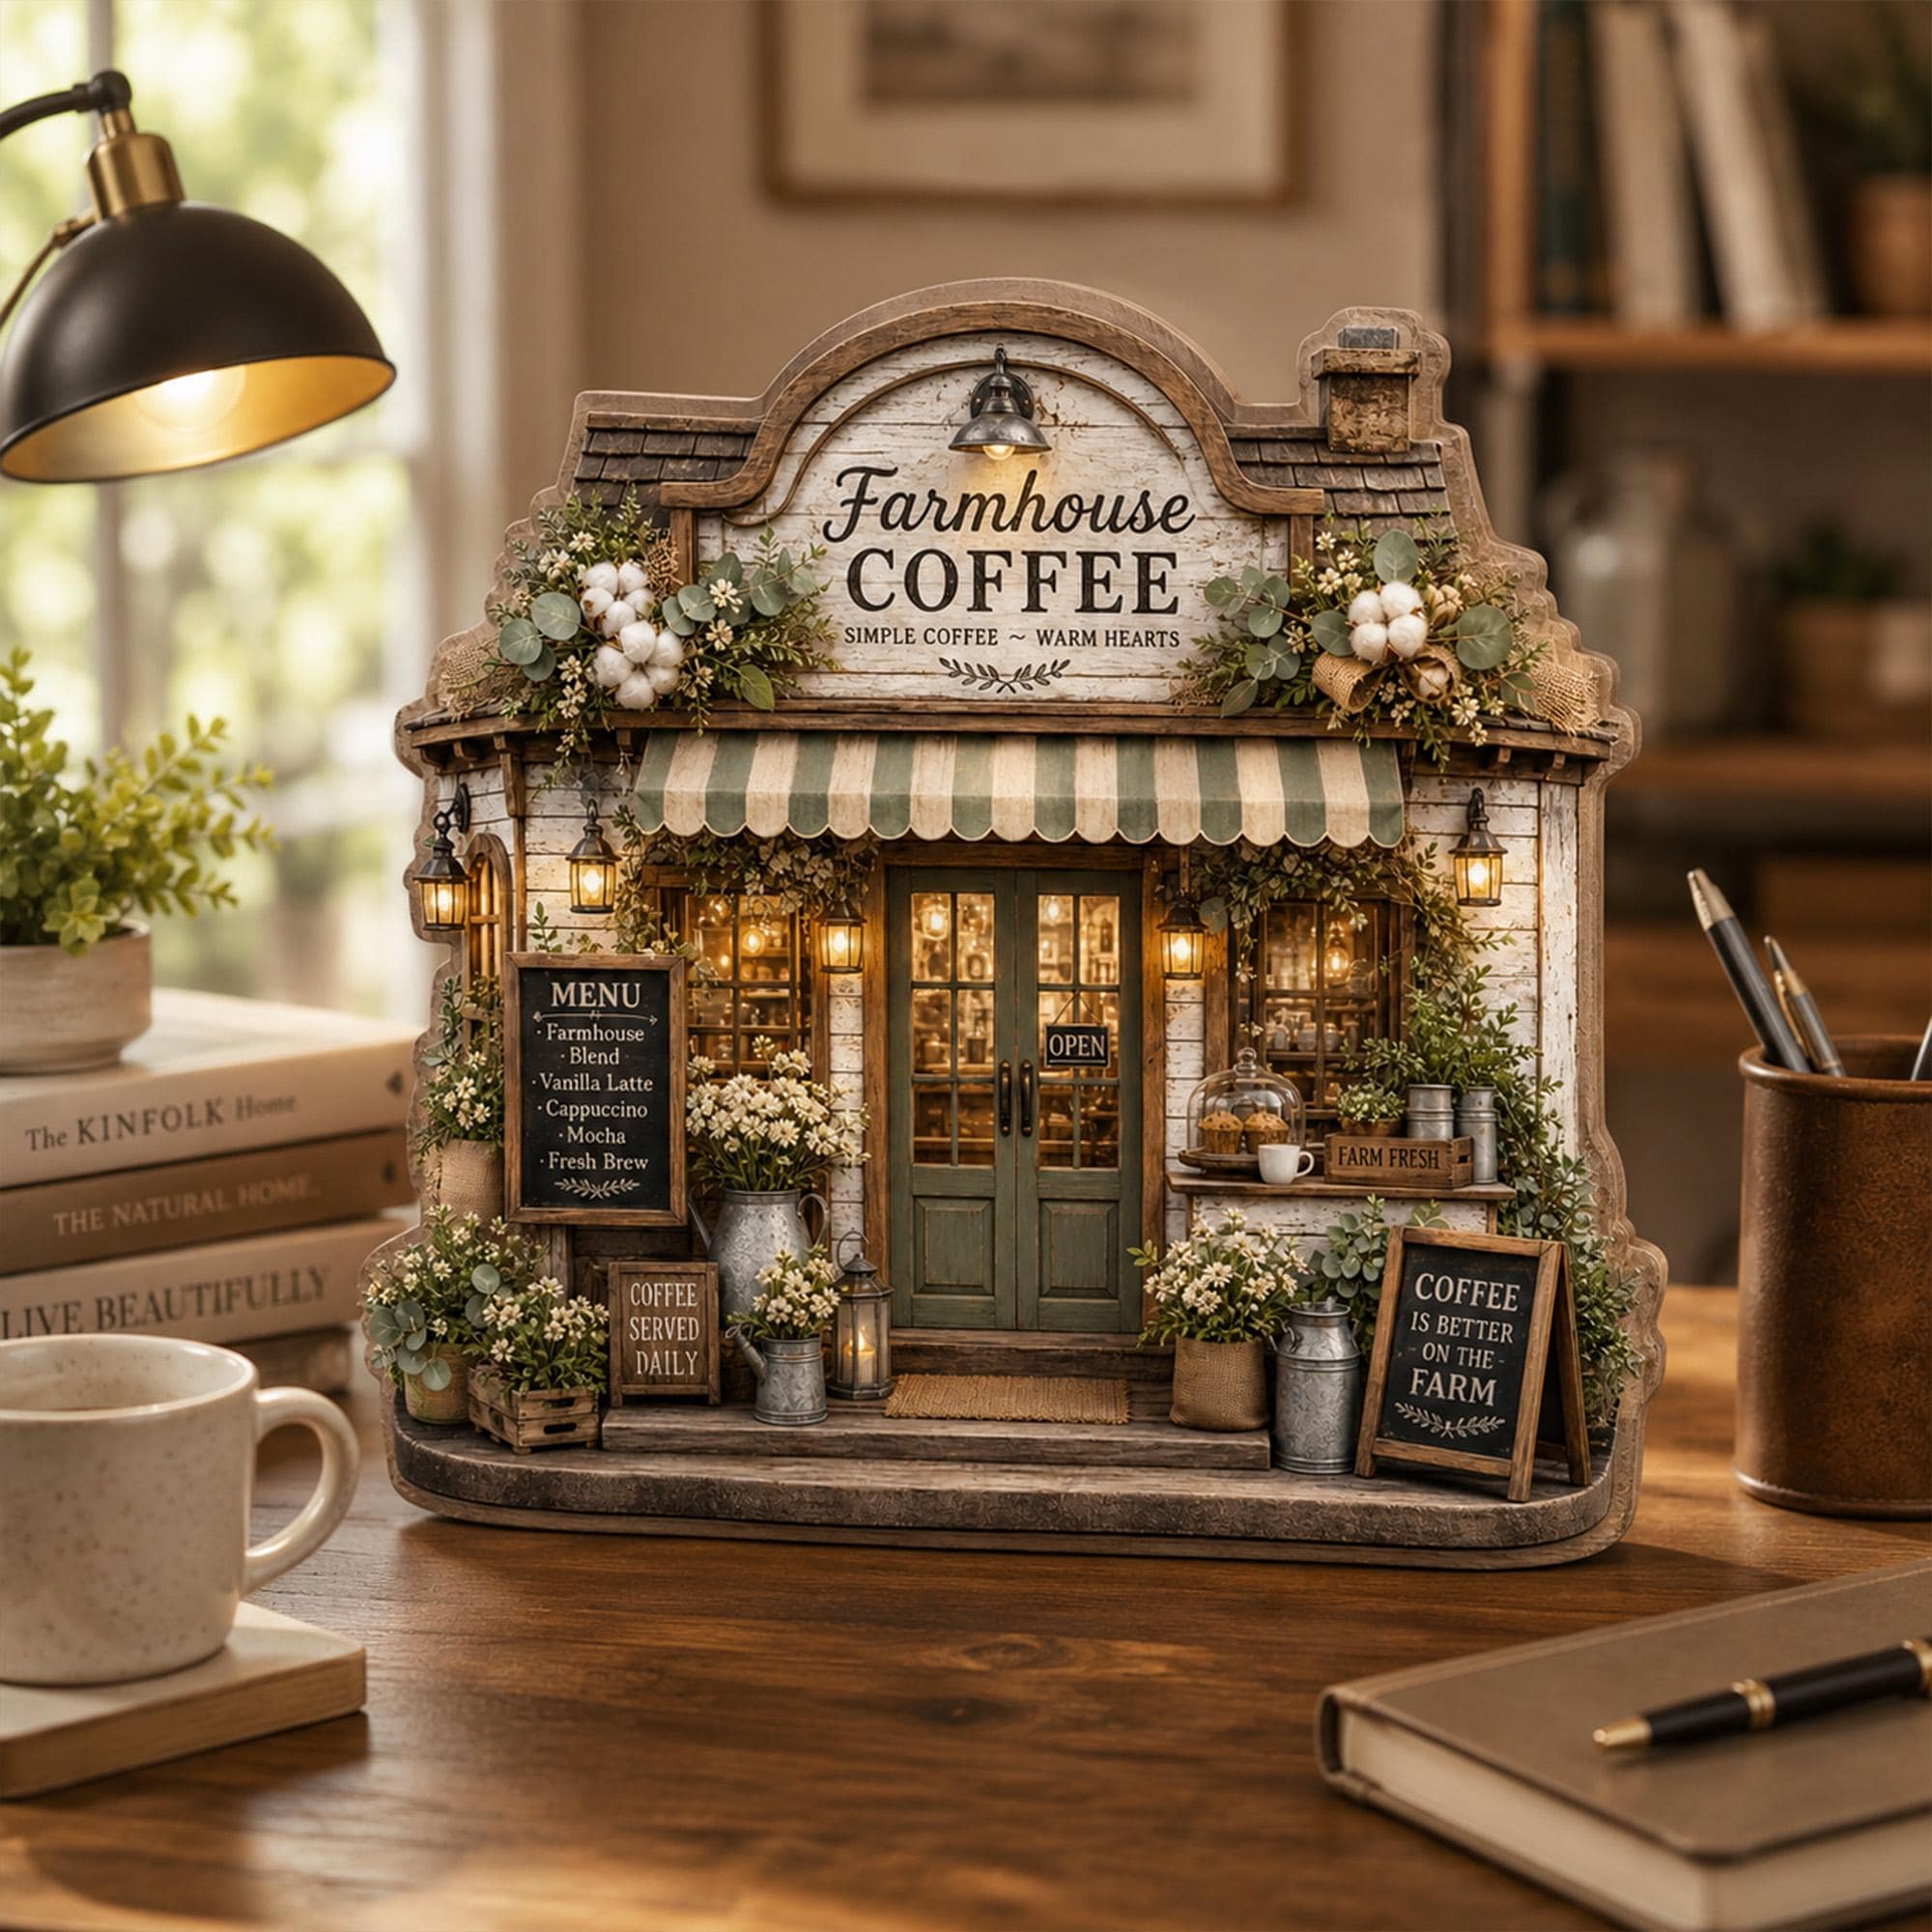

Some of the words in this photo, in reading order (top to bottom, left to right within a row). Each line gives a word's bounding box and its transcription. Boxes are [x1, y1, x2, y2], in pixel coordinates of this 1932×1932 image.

[822, 466, 1196, 543] Farmhouse
[846, 548, 1179, 614] COFFEE
[844, 627, 916, 645] SIMPLE
[923, 627, 998, 646] COFFEE
[1036, 629, 1097, 647] WARM
[1105, 630, 1180, 648] HEARTS
[551, 981, 641, 1009] MENU
[546, 1023, 645, 1042] Farmhouse
[570, 1046, 620, 1065] Blend
[1049, 1034, 1105, 1057] OPEN
[539, 1073, 600, 1092] Vanilla
[607, 1074, 654, 1093] Latte
[546, 1099, 648, 1122] Cappuccino
[25, 1126, 67, 1151] The
[76, 1097, 225, 1146] KINFOLK
[567, 1125, 626, 1145] Mocha
[548, 1151, 597, 1171] Fresh
[604, 1152, 649, 1171] Brew
[1338, 1147, 1382, 1167] FARM
[1389, 1148, 1439, 1169] FRESH
[53, 1208, 104, 1236] THE
[112, 1187, 233, 1227] NATURAL
[1, 1299, 83, 1340] LIVE
[95, 1265, 330, 1331] BEAUTIFULLY
[630, 1282, 697, 1307] COFFEE
[1415, 1273, 1520, 1312] COFFEE
[629, 1317, 699, 1341] SERVED
[1410, 1312, 1430, 1332] IS
[1436, 1317, 1514, 1344] BETTER
[636, 1350, 697, 1376] DAILY
[1422, 1342, 1450, 1363] ON
[1457, 1347, 1494, 1370] THE
[1408, 1368, 1496, 1406] FARM
